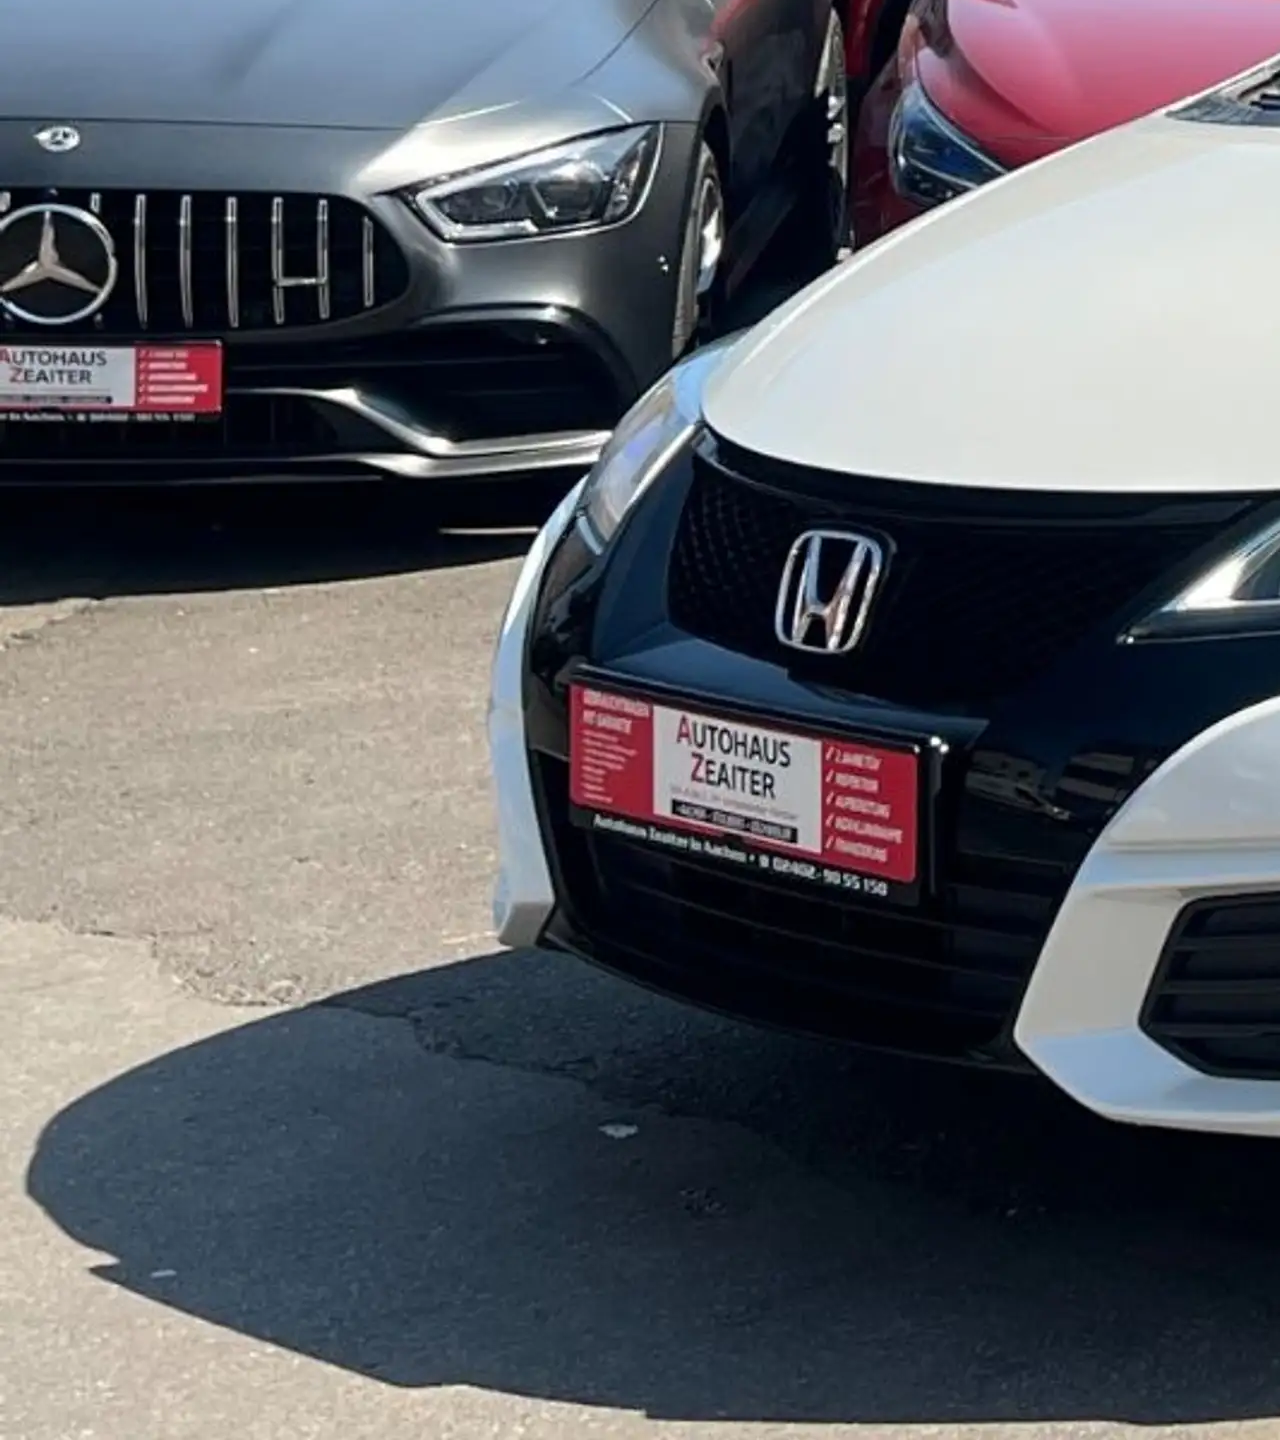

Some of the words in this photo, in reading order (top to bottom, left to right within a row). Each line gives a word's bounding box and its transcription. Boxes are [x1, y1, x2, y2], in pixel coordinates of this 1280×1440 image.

[0, 348, 108, 367] AUTOHAUS
[9, 367, 93, 385] ZEAITER
[676, 714, 792, 769] AUTOHAUS
[690, 751, 777, 800] ZEAITER
